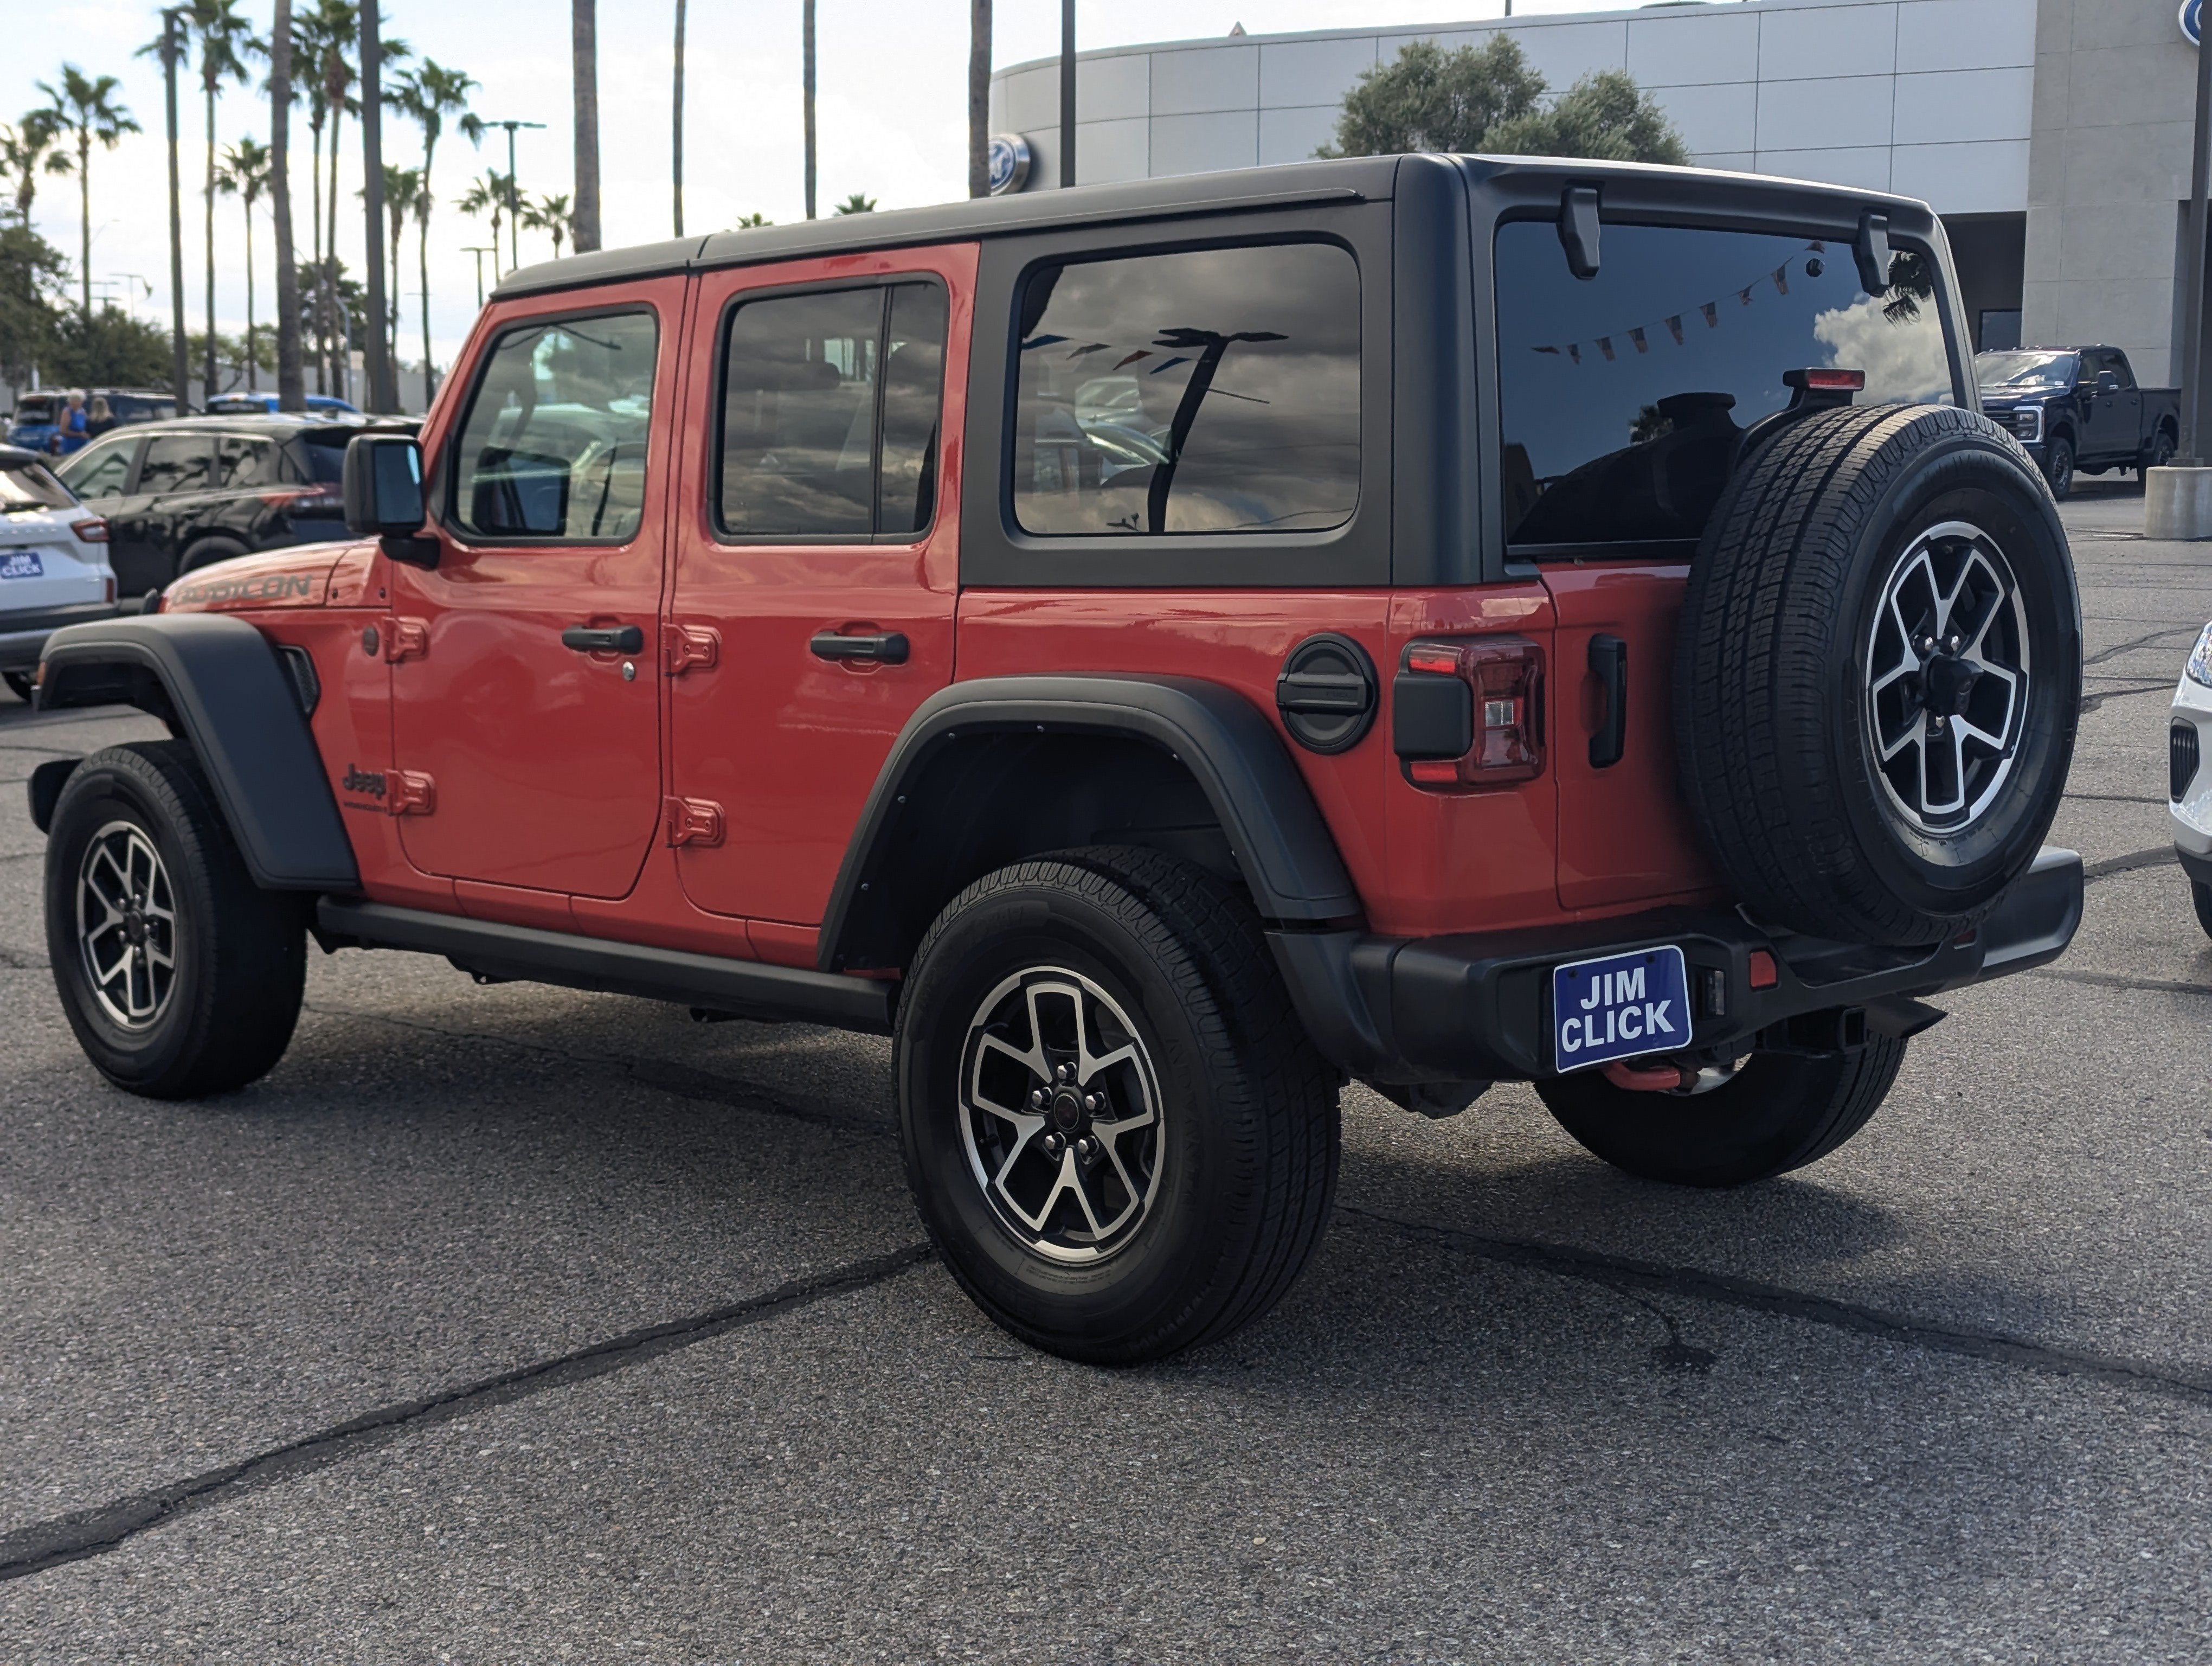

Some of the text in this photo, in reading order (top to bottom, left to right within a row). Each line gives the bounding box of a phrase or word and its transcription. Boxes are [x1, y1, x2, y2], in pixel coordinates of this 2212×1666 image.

[172, 574, 313, 606] RUBICON
[342, 762, 387, 800] Jeep
[1580, 966, 1646, 1010] JIM
[1561, 999, 1675, 1053] CLICK
